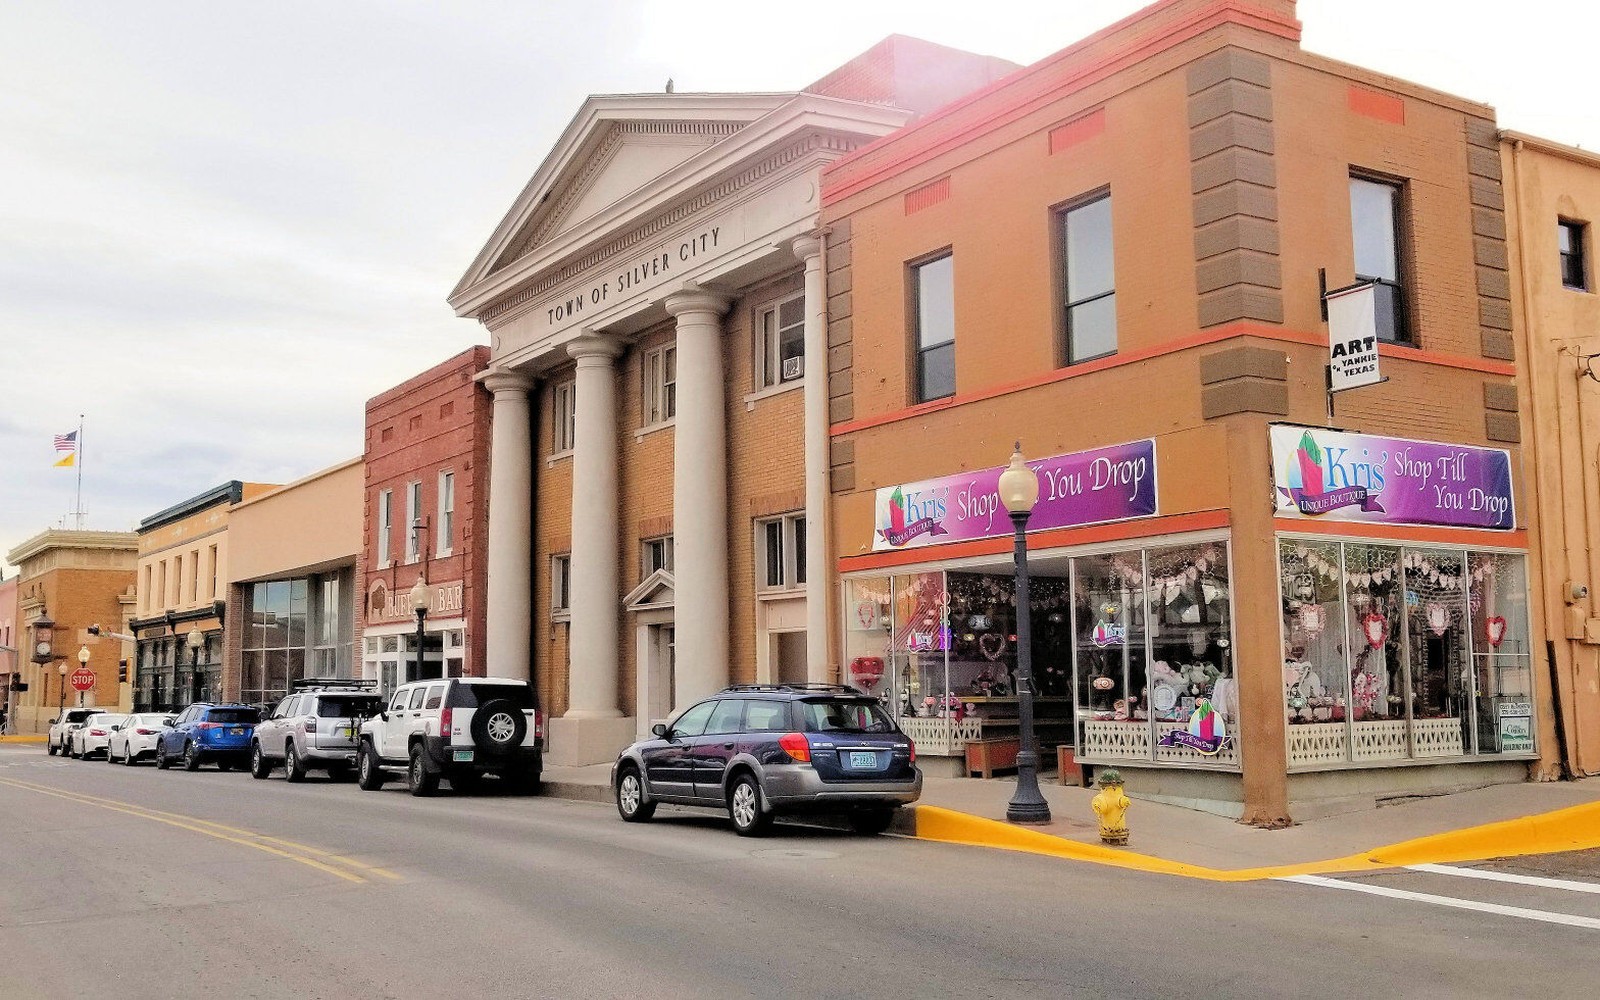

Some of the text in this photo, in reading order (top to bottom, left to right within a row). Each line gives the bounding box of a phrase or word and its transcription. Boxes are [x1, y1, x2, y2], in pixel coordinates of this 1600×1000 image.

[547, 226, 720, 325] TOWN OF SILVER CITY
[1331, 336, 1376, 359] ART
[1341, 353, 1378, 368] YANKIE
[1343, 364, 1376, 377] TEXAS
[1323, 446, 1389, 492] Kris'
[1394, 446, 1469, 491] Shop Till
[905, 486, 950, 524] Kris'
[957, 481, 998, 532] Shop
[1045, 466, 1084, 502] You
[1089, 455, 1147, 501] Drop
[1434, 484, 1509, 525] You Drop
[388, 585, 463, 617] BUFF BAR
[72, 675, 94, 685] STOP
